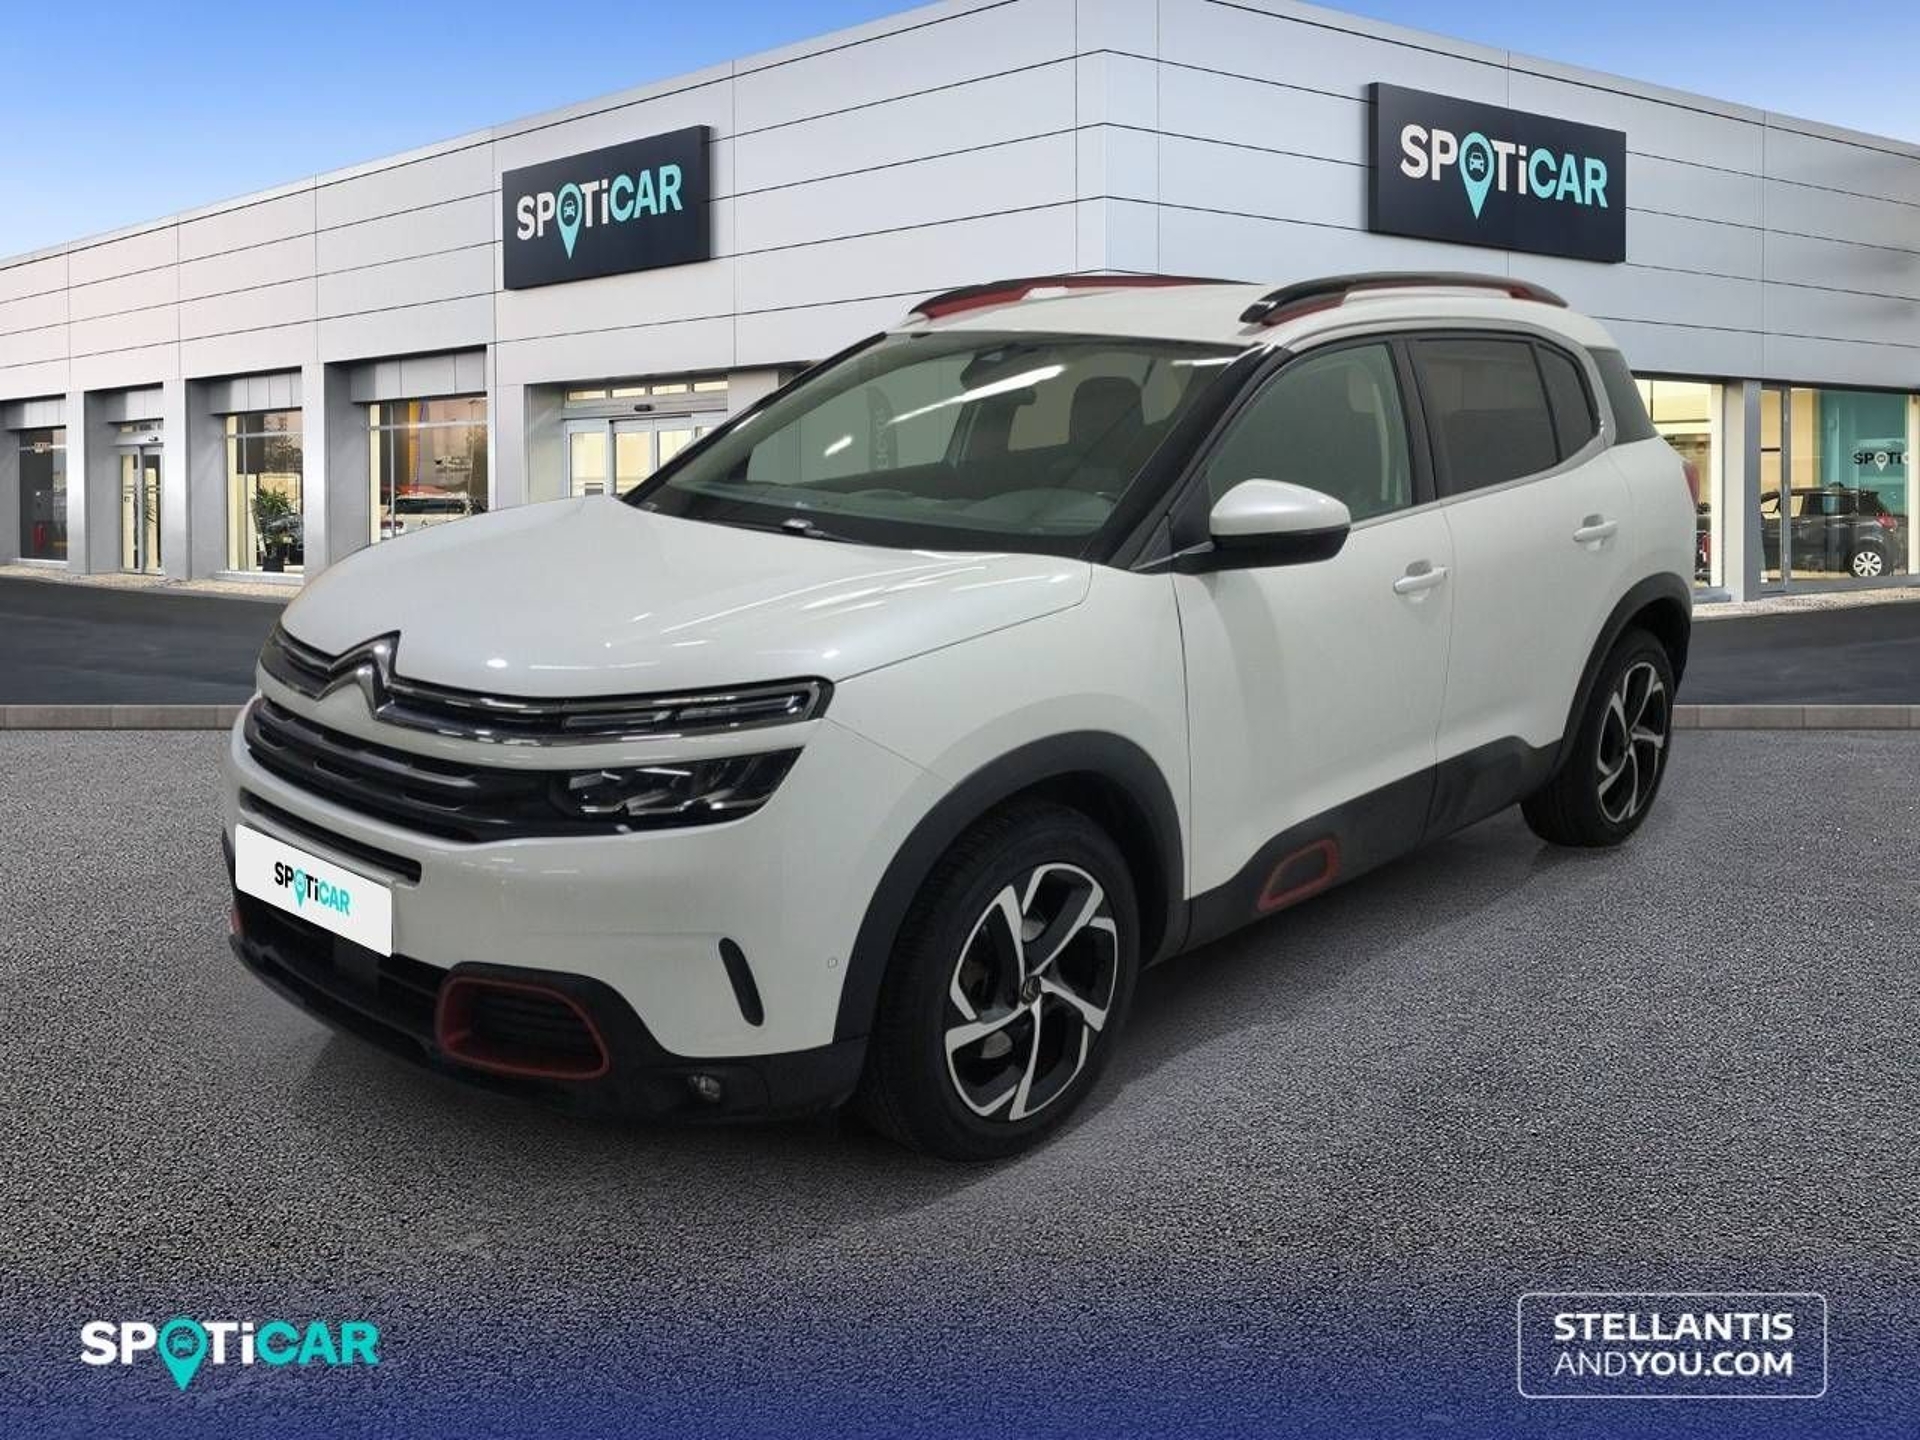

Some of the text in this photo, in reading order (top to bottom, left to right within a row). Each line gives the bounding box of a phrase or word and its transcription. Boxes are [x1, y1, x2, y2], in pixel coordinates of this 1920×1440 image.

[516, 164, 683, 259] SPOTiCAR
[1400, 123, 1609, 219] SPOTiCAR
[274, 861, 350, 915] SPOTiCAR
